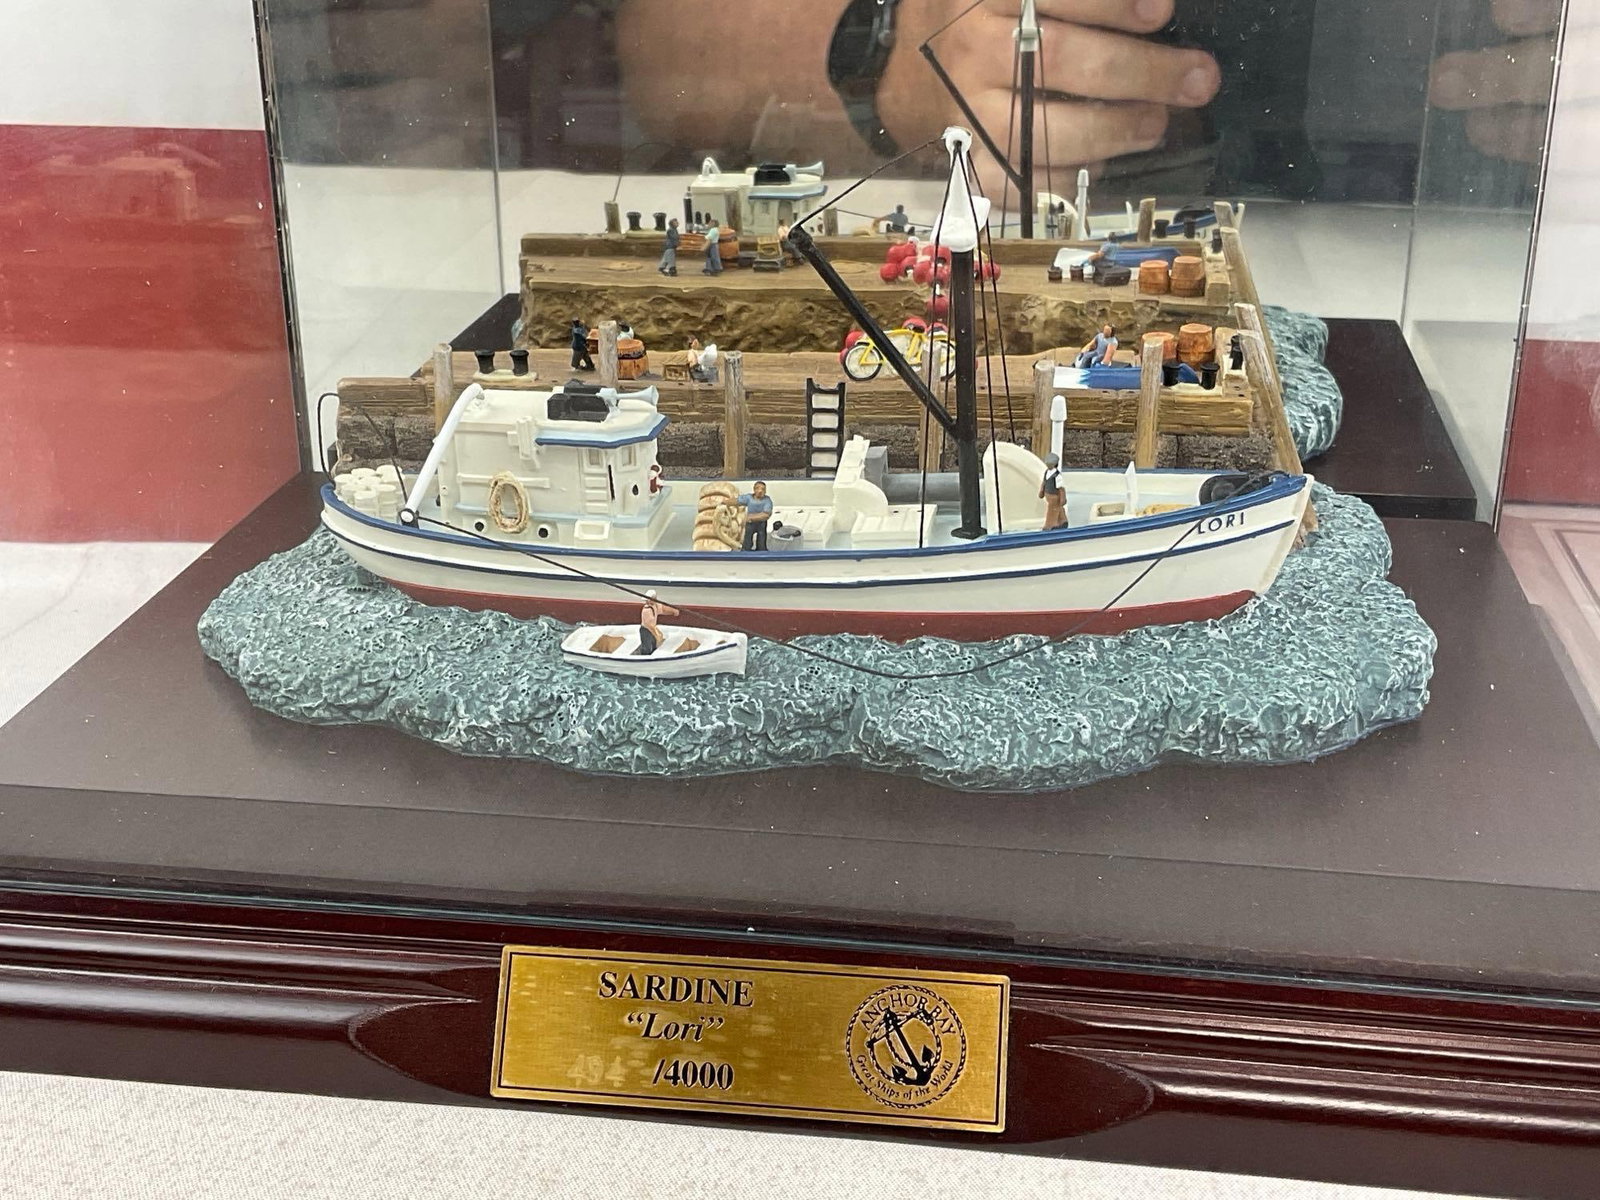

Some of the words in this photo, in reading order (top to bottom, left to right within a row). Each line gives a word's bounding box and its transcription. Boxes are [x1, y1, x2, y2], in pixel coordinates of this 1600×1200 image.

[1197, 511, 1245, 534] LORI
[598, 971, 754, 1007] SARDINE
[861, 993, 928, 1031] ANCHOR
[929, 1005, 956, 1035] BAY
[652, 1058, 735, 1090] /4000
[856, 1054, 876, 1082] Great
[875, 1079, 900, 1099] Ships
[903, 1088, 913, 1101] of
[915, 1084, 931, 1098] the
[930, 1059, 954, 1090] World
